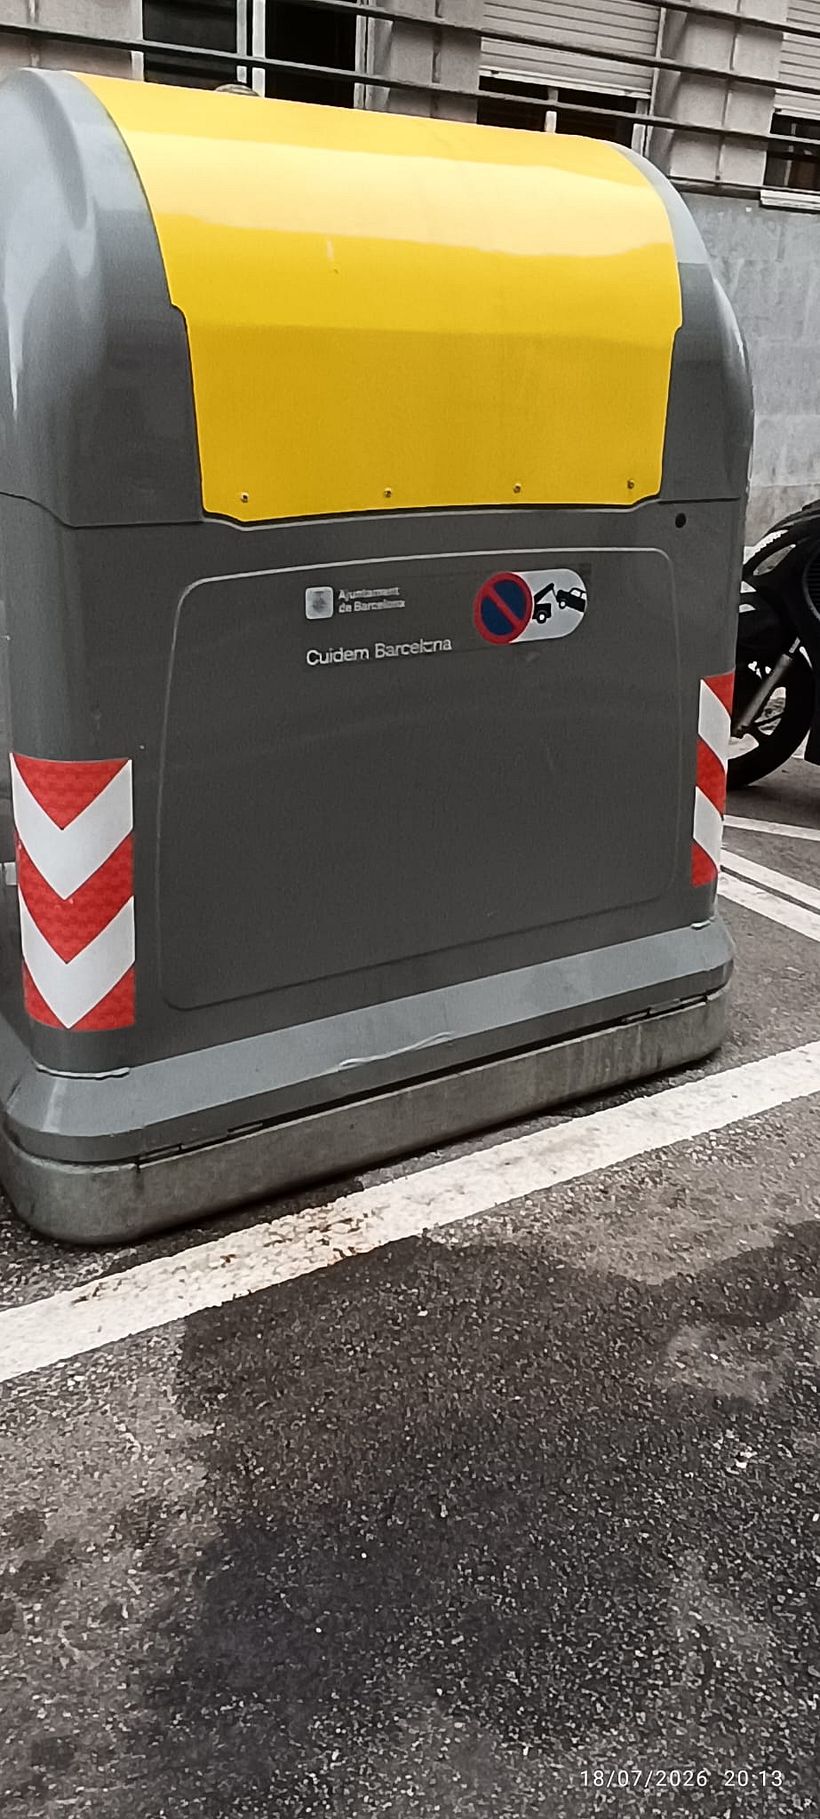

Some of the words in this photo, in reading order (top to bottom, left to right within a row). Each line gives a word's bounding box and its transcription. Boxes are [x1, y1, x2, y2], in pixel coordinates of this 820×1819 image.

[338, 602, 352, 613] de
[306, 647, 370, 666] Cuidem
[374, 638, 452, 659] Barcelona
